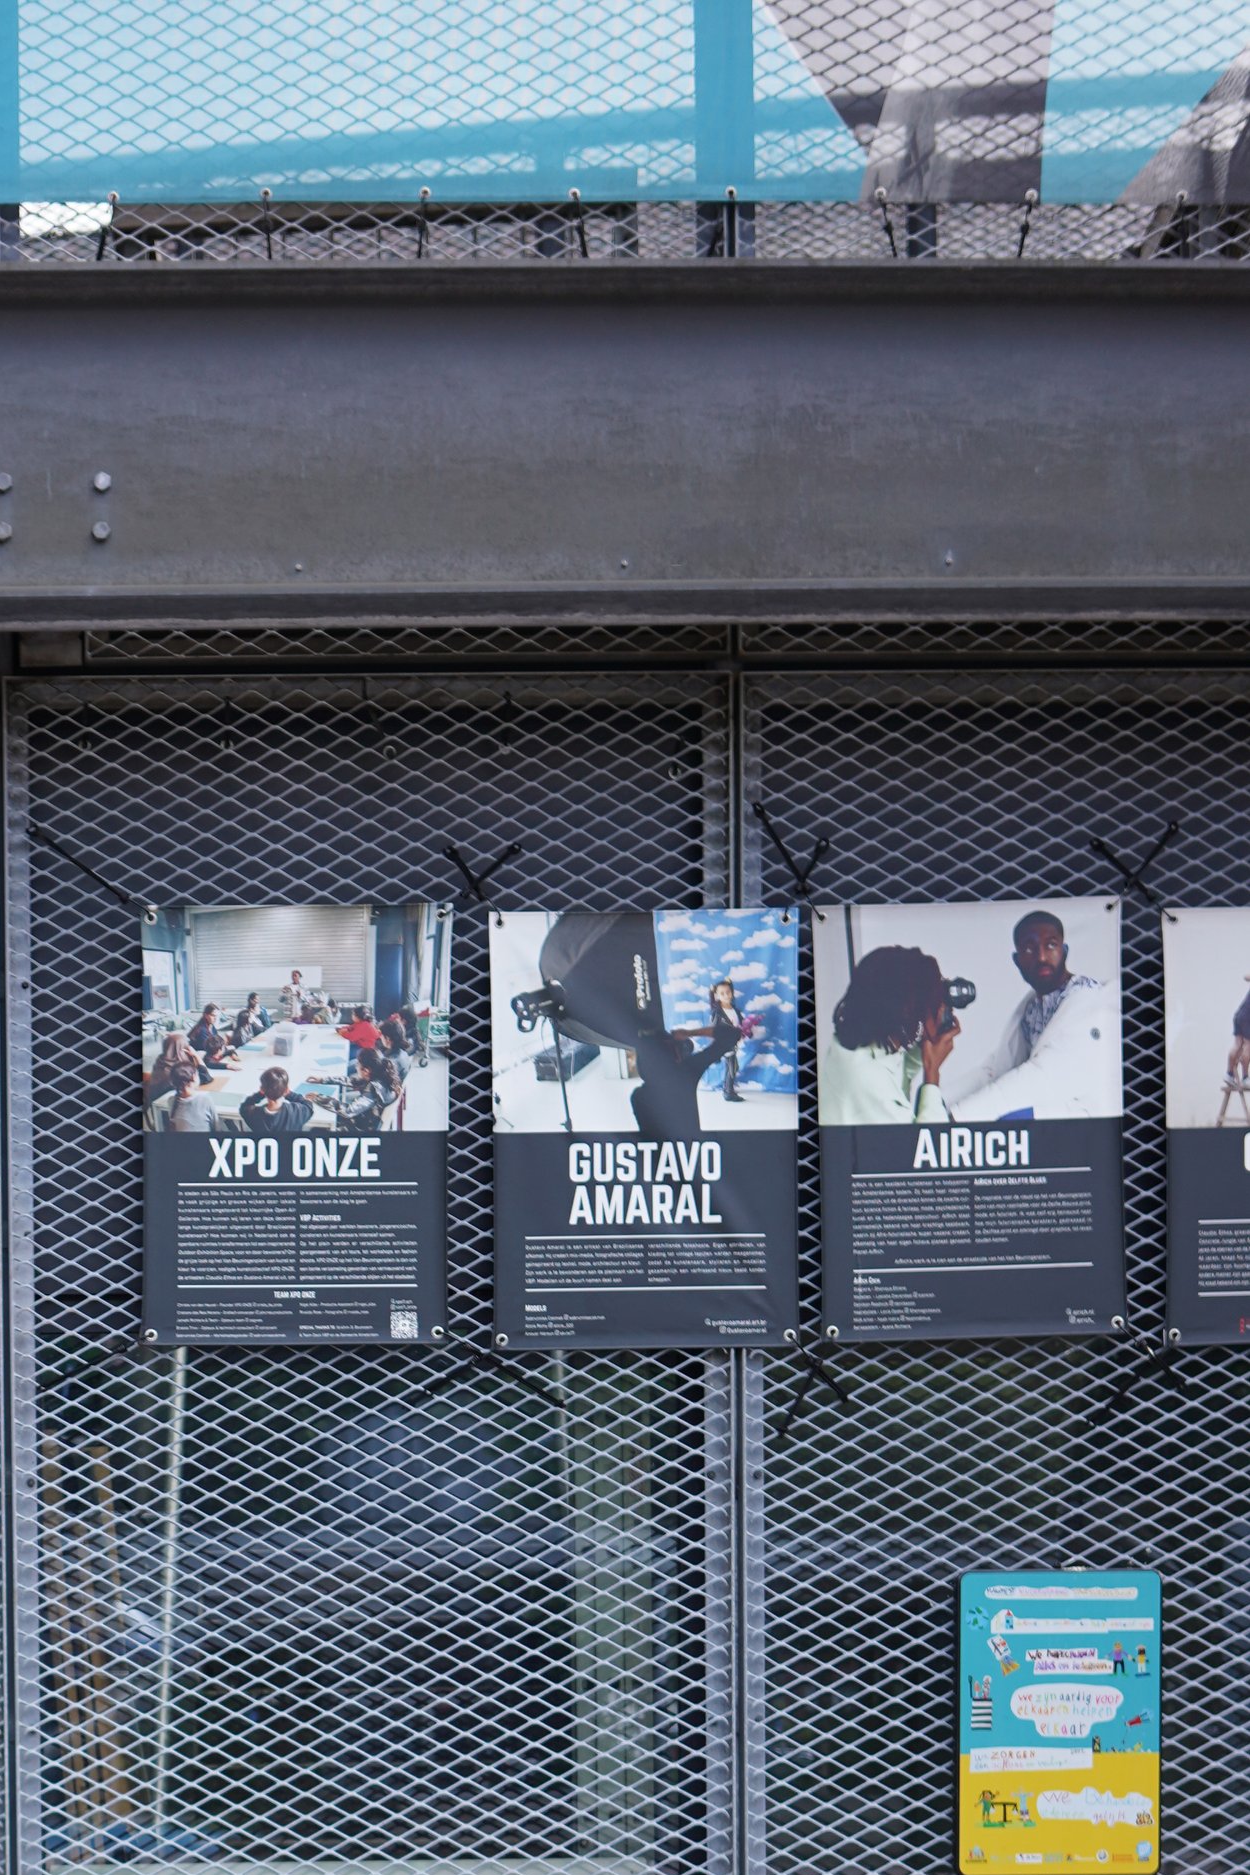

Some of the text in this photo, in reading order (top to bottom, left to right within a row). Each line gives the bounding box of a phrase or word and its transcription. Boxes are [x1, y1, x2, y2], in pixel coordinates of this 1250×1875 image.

[209, 1137, 382, 1178] XPO ONZE
[569, 1141, 722, 1183] GUSTAVO
[569, 1184, 722, 1226] AMARAL
